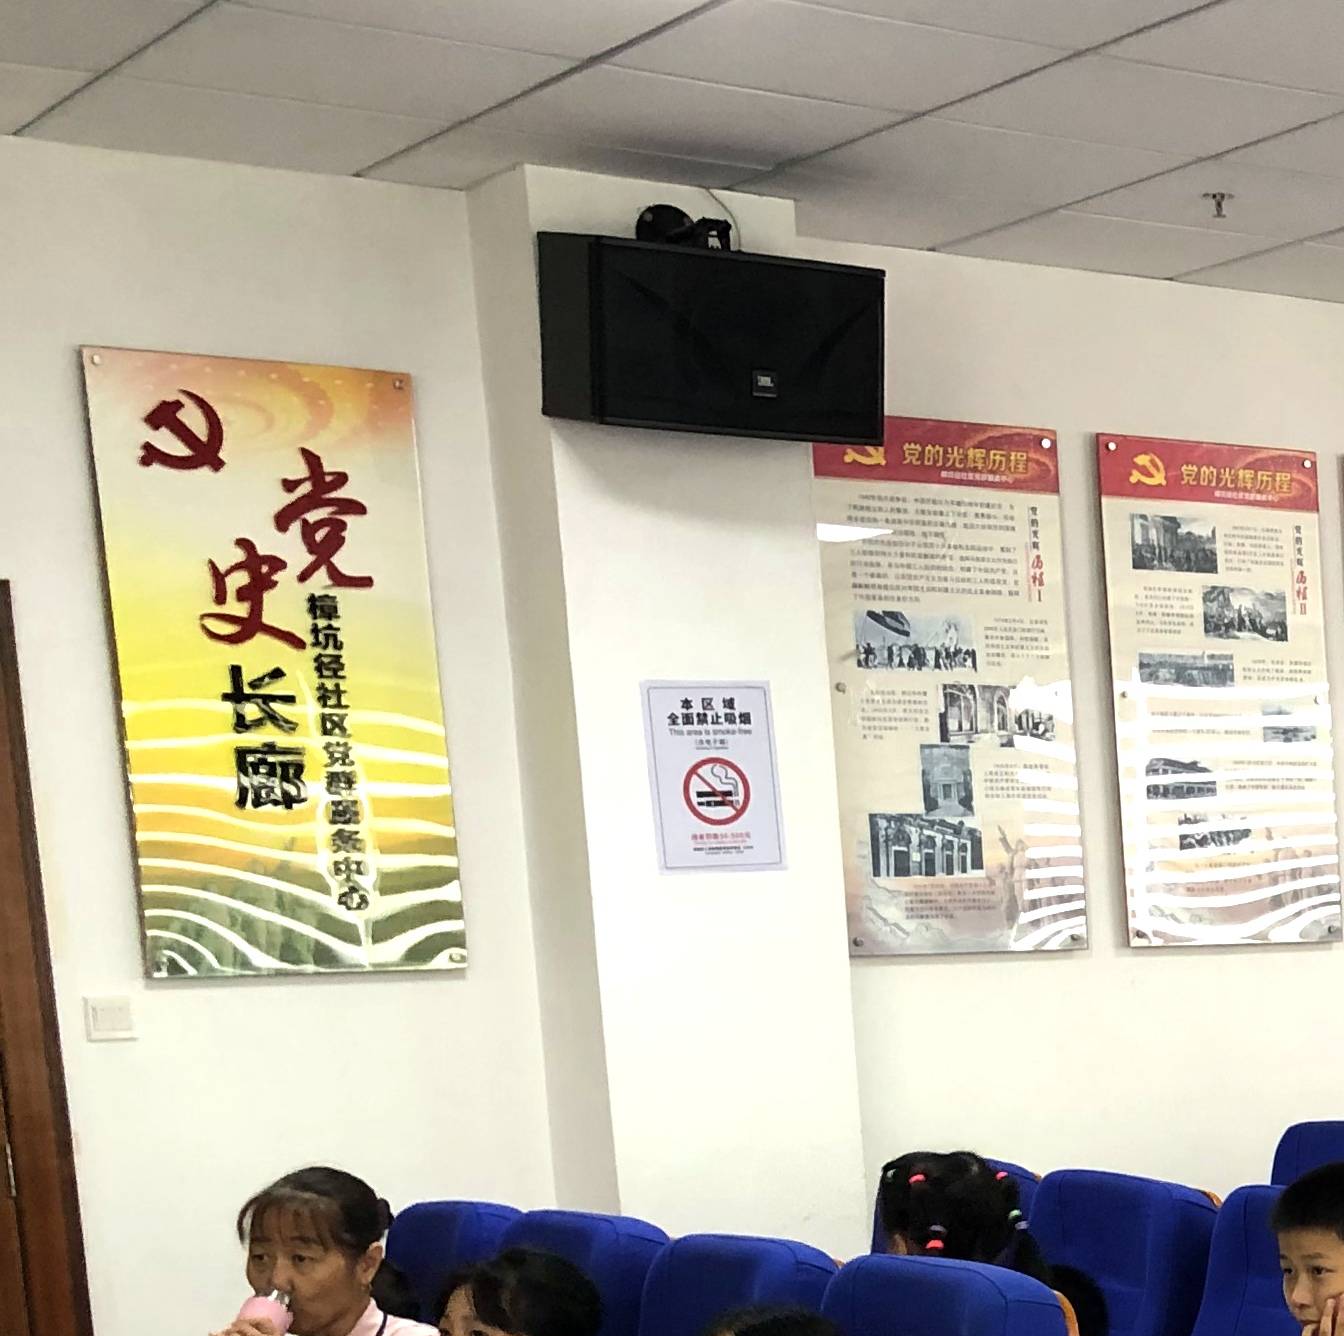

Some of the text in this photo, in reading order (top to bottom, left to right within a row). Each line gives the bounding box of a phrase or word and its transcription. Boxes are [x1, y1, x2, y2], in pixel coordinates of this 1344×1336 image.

[902, 441, 1028, 475] 党的光辉历程
[1180, 463, 1293, 494] 党的光辉历程
[667, 711, 752, 726] 全面禁止吸烟
[680, 697, 736, 711] 本区域
[306, 592, 370, 911] 樟坑径社区党群服务中心
